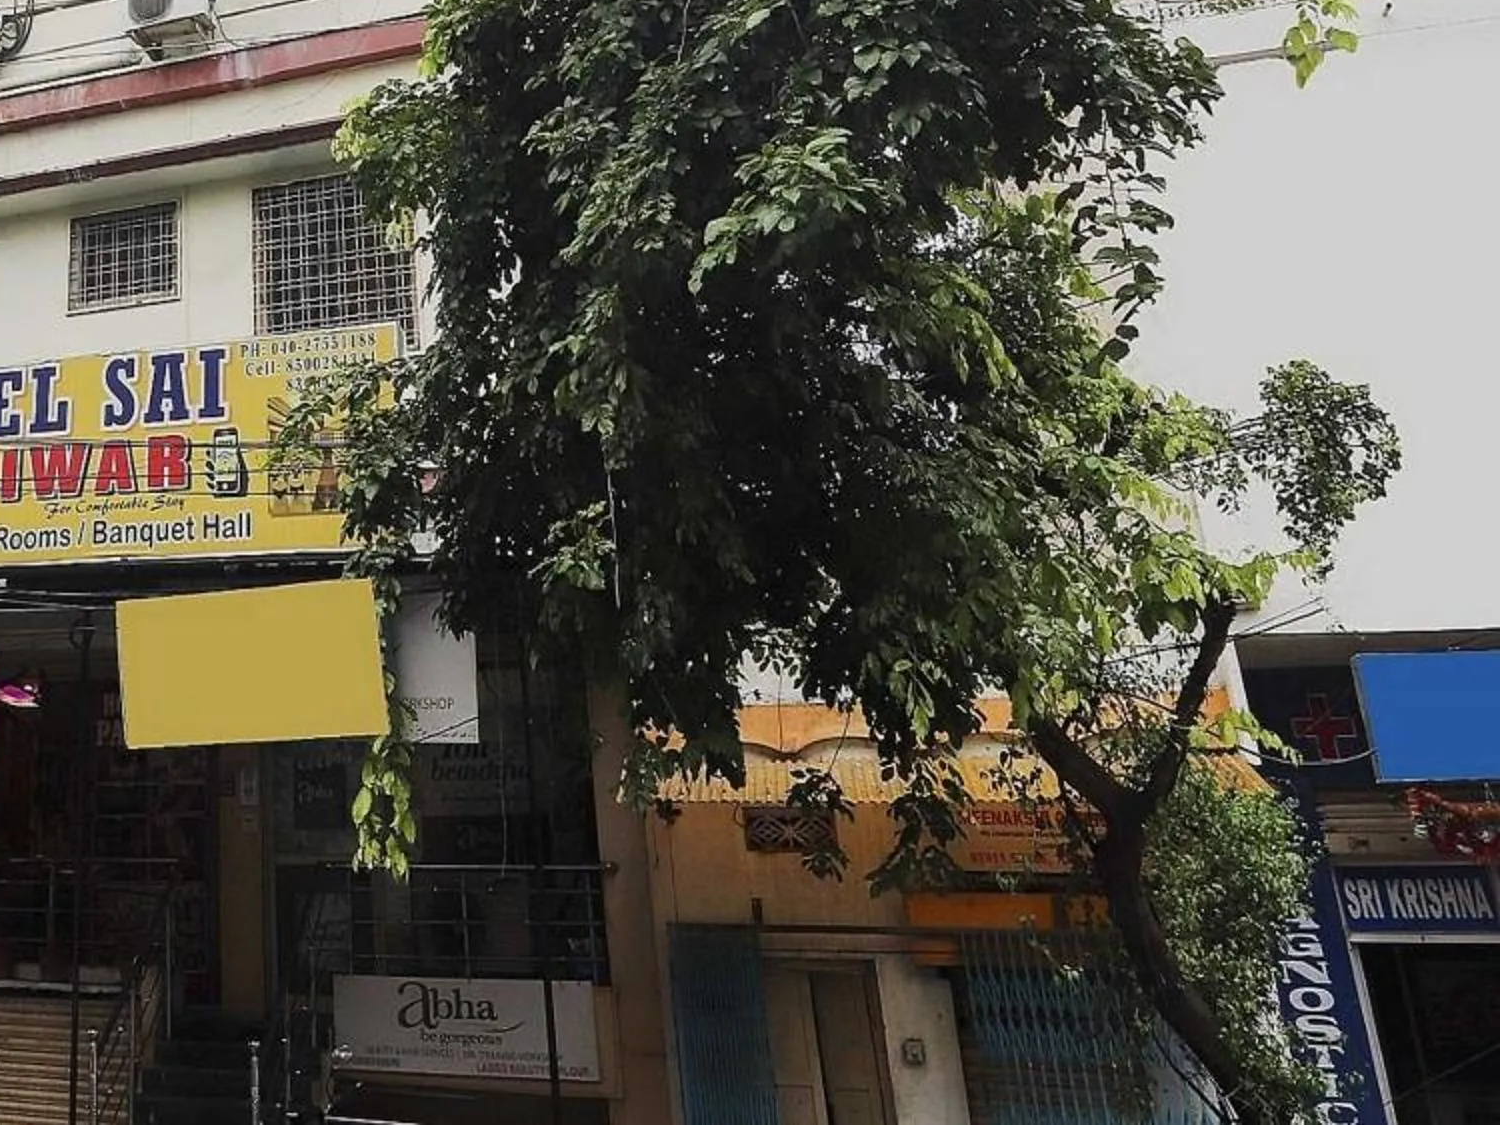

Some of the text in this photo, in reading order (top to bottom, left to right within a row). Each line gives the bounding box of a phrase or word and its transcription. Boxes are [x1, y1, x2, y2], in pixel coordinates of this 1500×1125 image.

[241, 343, 266, 358] PH:
[245, 360, 280, 376] Cell:
[103, 348, 227, 427] SAI
[75, 497, 149, 516] Comfortable
[92, 517, 195, 548] Banquet
[202, 512, 251, 540] Hall
[1343, 878, 1495, 920] SRI KRISHNA
[419, 1028, 438, 1042] be
